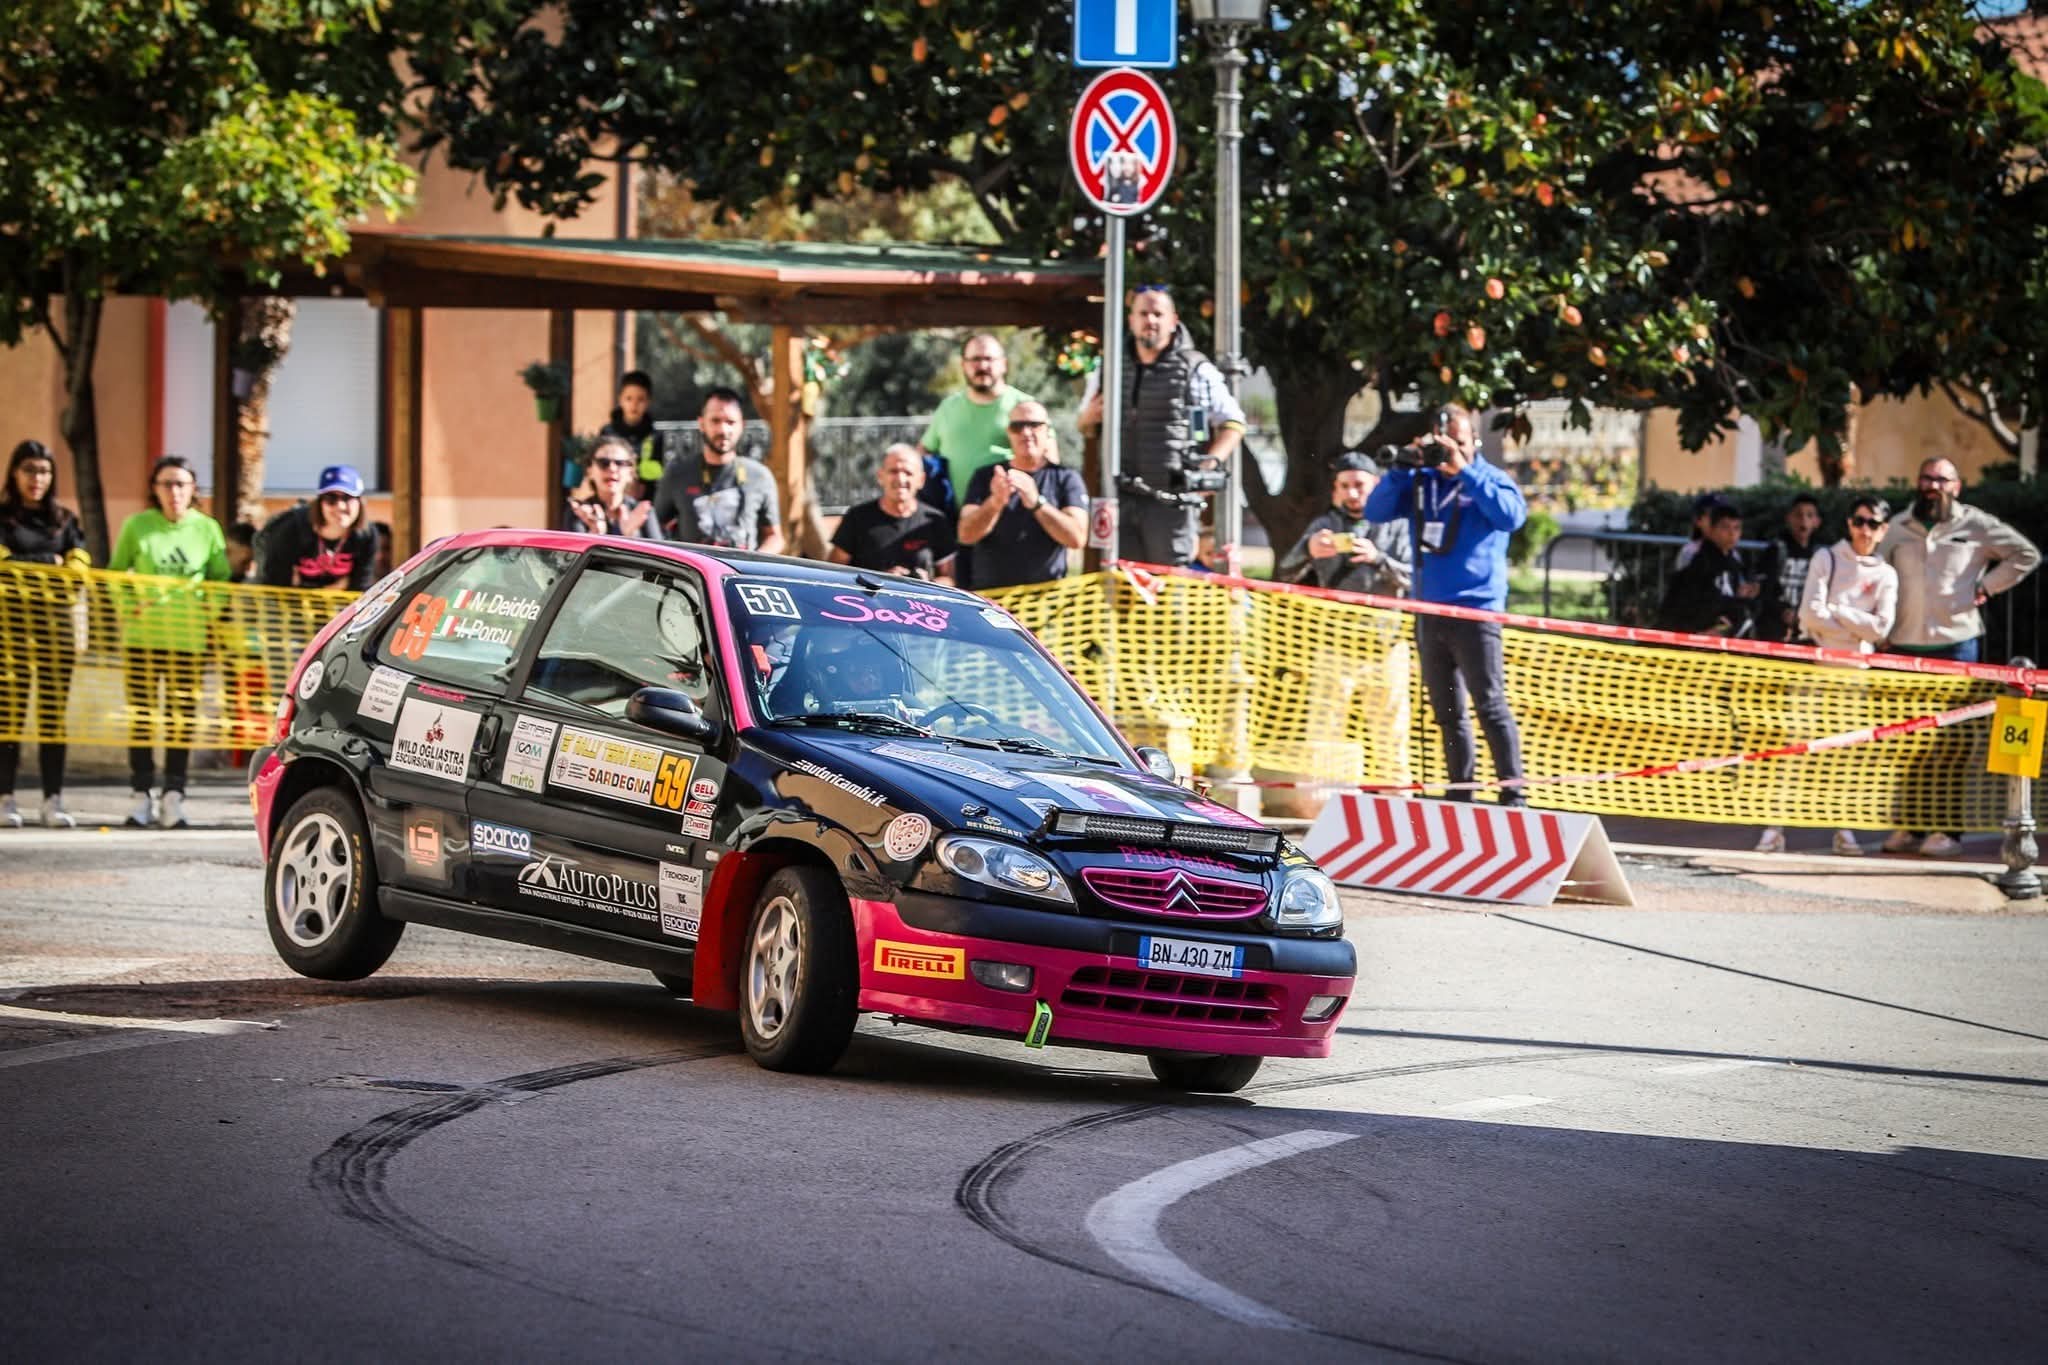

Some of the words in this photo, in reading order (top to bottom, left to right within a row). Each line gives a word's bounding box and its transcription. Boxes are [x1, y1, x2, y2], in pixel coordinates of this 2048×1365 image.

[470, 591, 487, 612] N.
[487, 594, 541, 621] Deidda
[743, 587, 794, 617] 59
[820, 595, 948, 632] Saxo
[389, 592, 447, 662] 59
[467, 619, 512, 645] Porcu
[2004, 725, 2029, 745] 84
[395, 751, 434, 770] ESCURSIONI
[435, 760, 443, 773] IN
[444, 761, 463, 777] QUAD
[398, 740, 417, 754] WILD
[419, 744, 465, 766] OGLIASTRA
[588, 767, 651, 795] SARDEGNA
[653, 754, 692, 811] 59
[694, 783, 715, 796] BELL
[798, 759, 888, 808] autoricambi.it
[473, 823, 530, 851] sparco
[664, 915, 698, 933] sparco
[881, 947, 956, 974] PIRELLI
[1152, 942, 1172, 965] BN
[1180, 946, 1209, 969] 430
[1213, 949, 1232, 972] ZM
